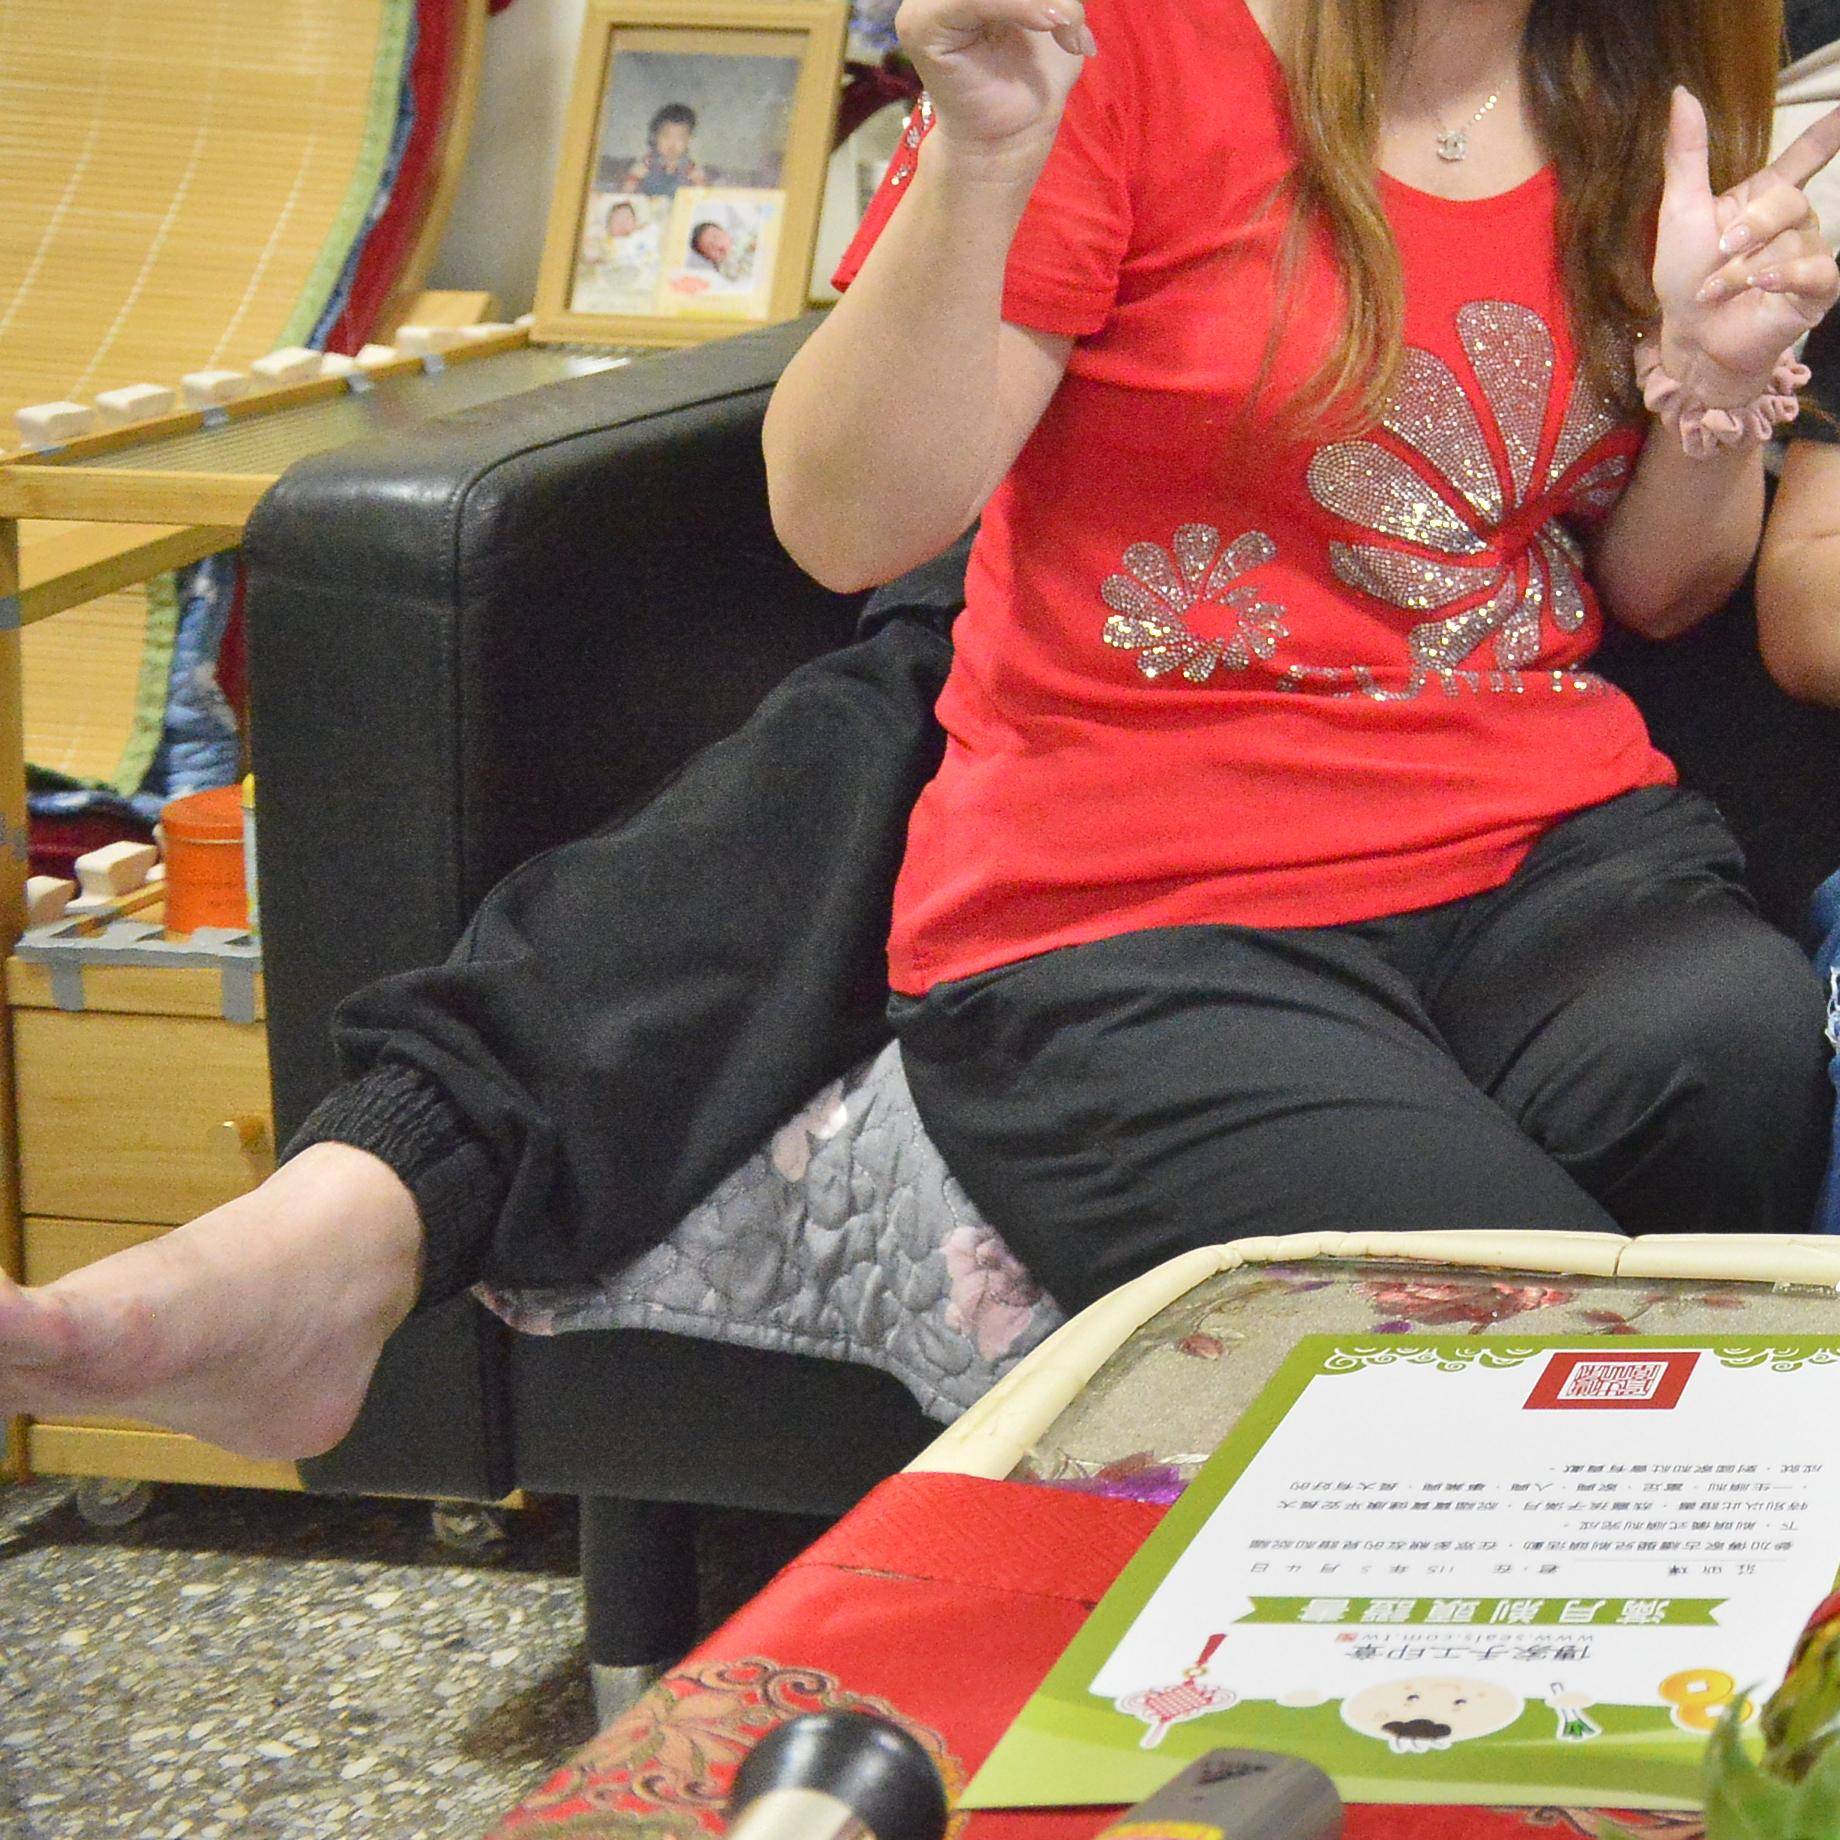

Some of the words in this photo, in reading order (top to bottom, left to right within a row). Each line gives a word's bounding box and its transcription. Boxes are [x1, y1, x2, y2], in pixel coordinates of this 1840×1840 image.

[1298, 1598, 1670, 1624] 滿月剃頭證書
[1342, 1642, 1592, 1662] 傳家手工印章
